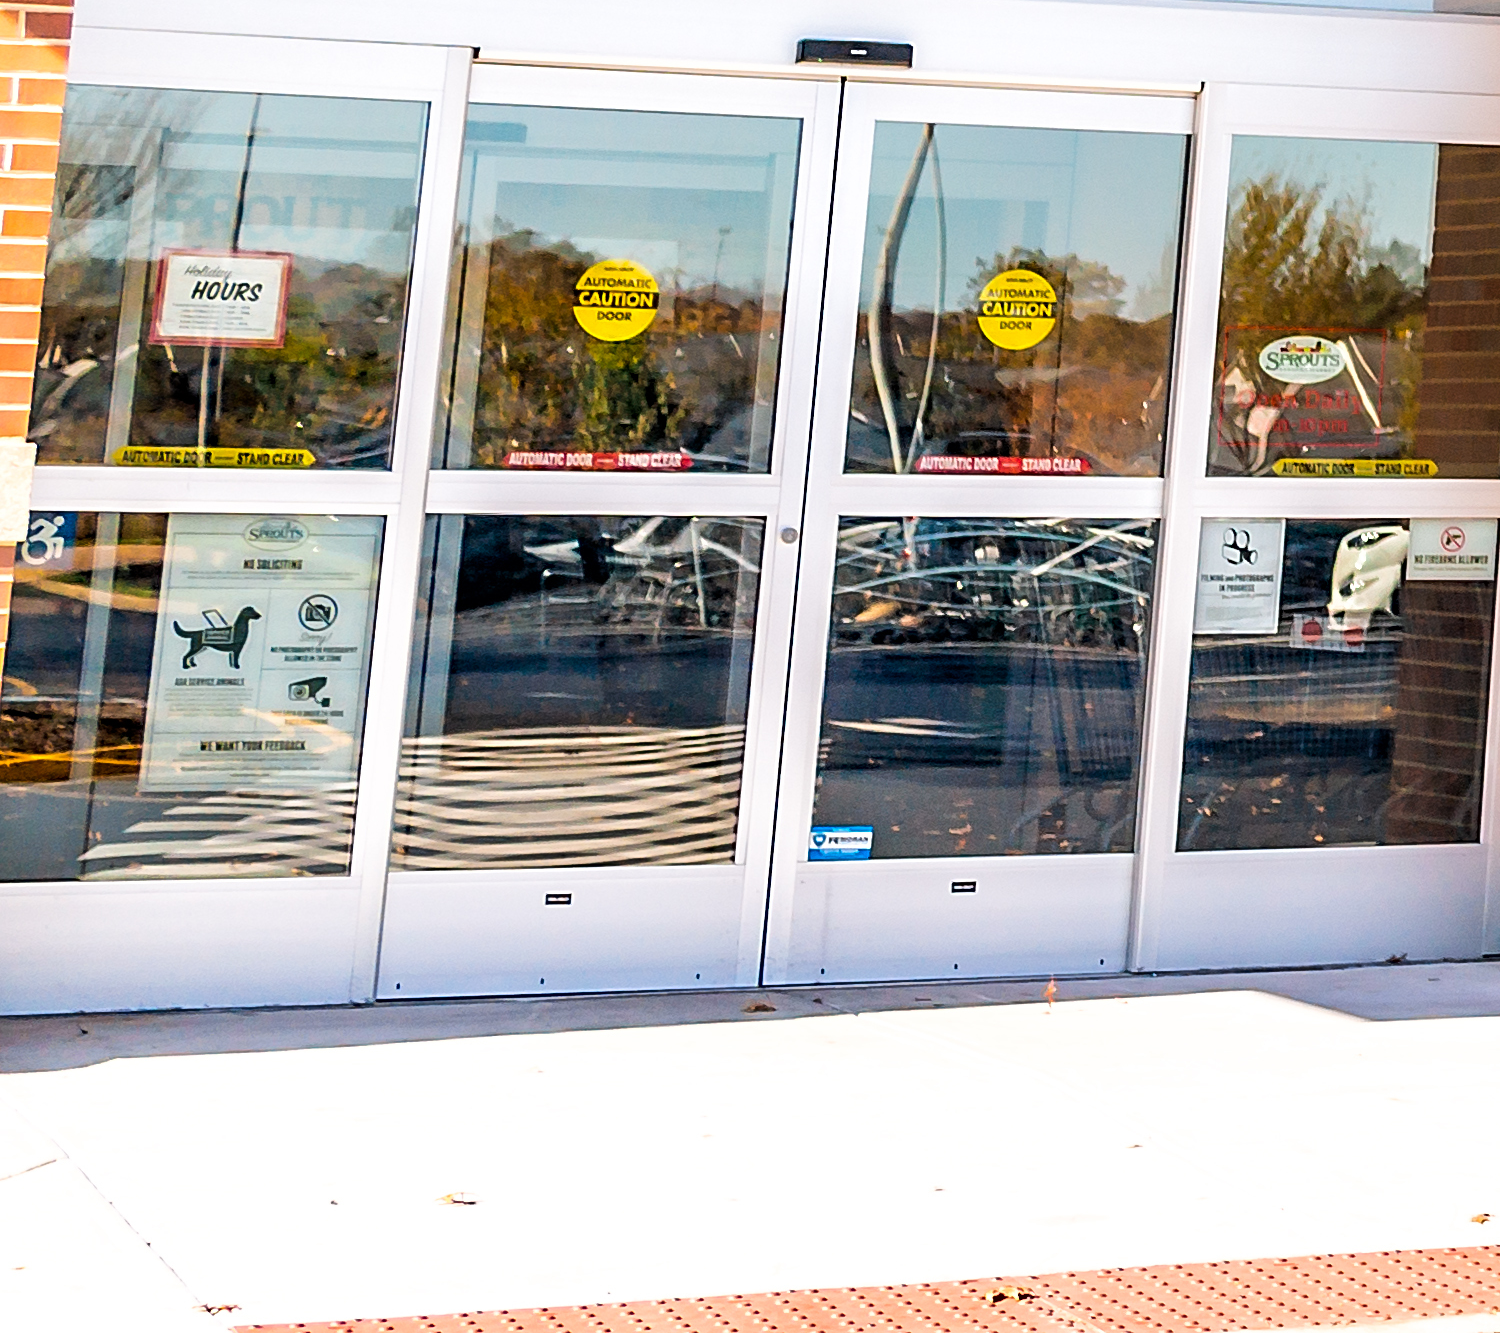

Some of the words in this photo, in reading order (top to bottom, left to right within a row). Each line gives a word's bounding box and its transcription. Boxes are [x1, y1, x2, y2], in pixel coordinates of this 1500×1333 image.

[584, 276, 652, 290] AUTOMATIC
[191, 280, 263, 302] HOURS
[988, 288, 1051, 299] AUTOMATIC
[579, 291, 654, 308] CAUTION
[597, 311, 632, 321] DOOR
[982, 301, 1052, 317] CAUTION
[1000, 320, 1032, 330] DOOR
[1265, 351, 1340, 371] SPROUTS
[1304, 390, 1361, 415] Daily
[122, 450, 181, 464] AUTOMATIC
[237, 452, 270, 465] STAND
[272, 452, 304, 465] CLEAR
[509, 452, 565, 466] AUTOMATIC
[566, 453, 593, 466] DOOR
[618, 453, 649, 467] STAND
[651, 453, 682, 467] CLEAR
[920, 457, 972, 470] AUTOMATIC
[974, 457, 999, 470] DOOR
[1022, 457, 1050, 471] STAND
[1052, 458, 1081, 471] CLEAR
[1282, 461, 1330, 474] AUTOMATIC
[1331, 462, 1355, 475] DOOR
[1375, 462, 1402, 475] STAND
[1403, 463, 1430, 475] CLEAR
